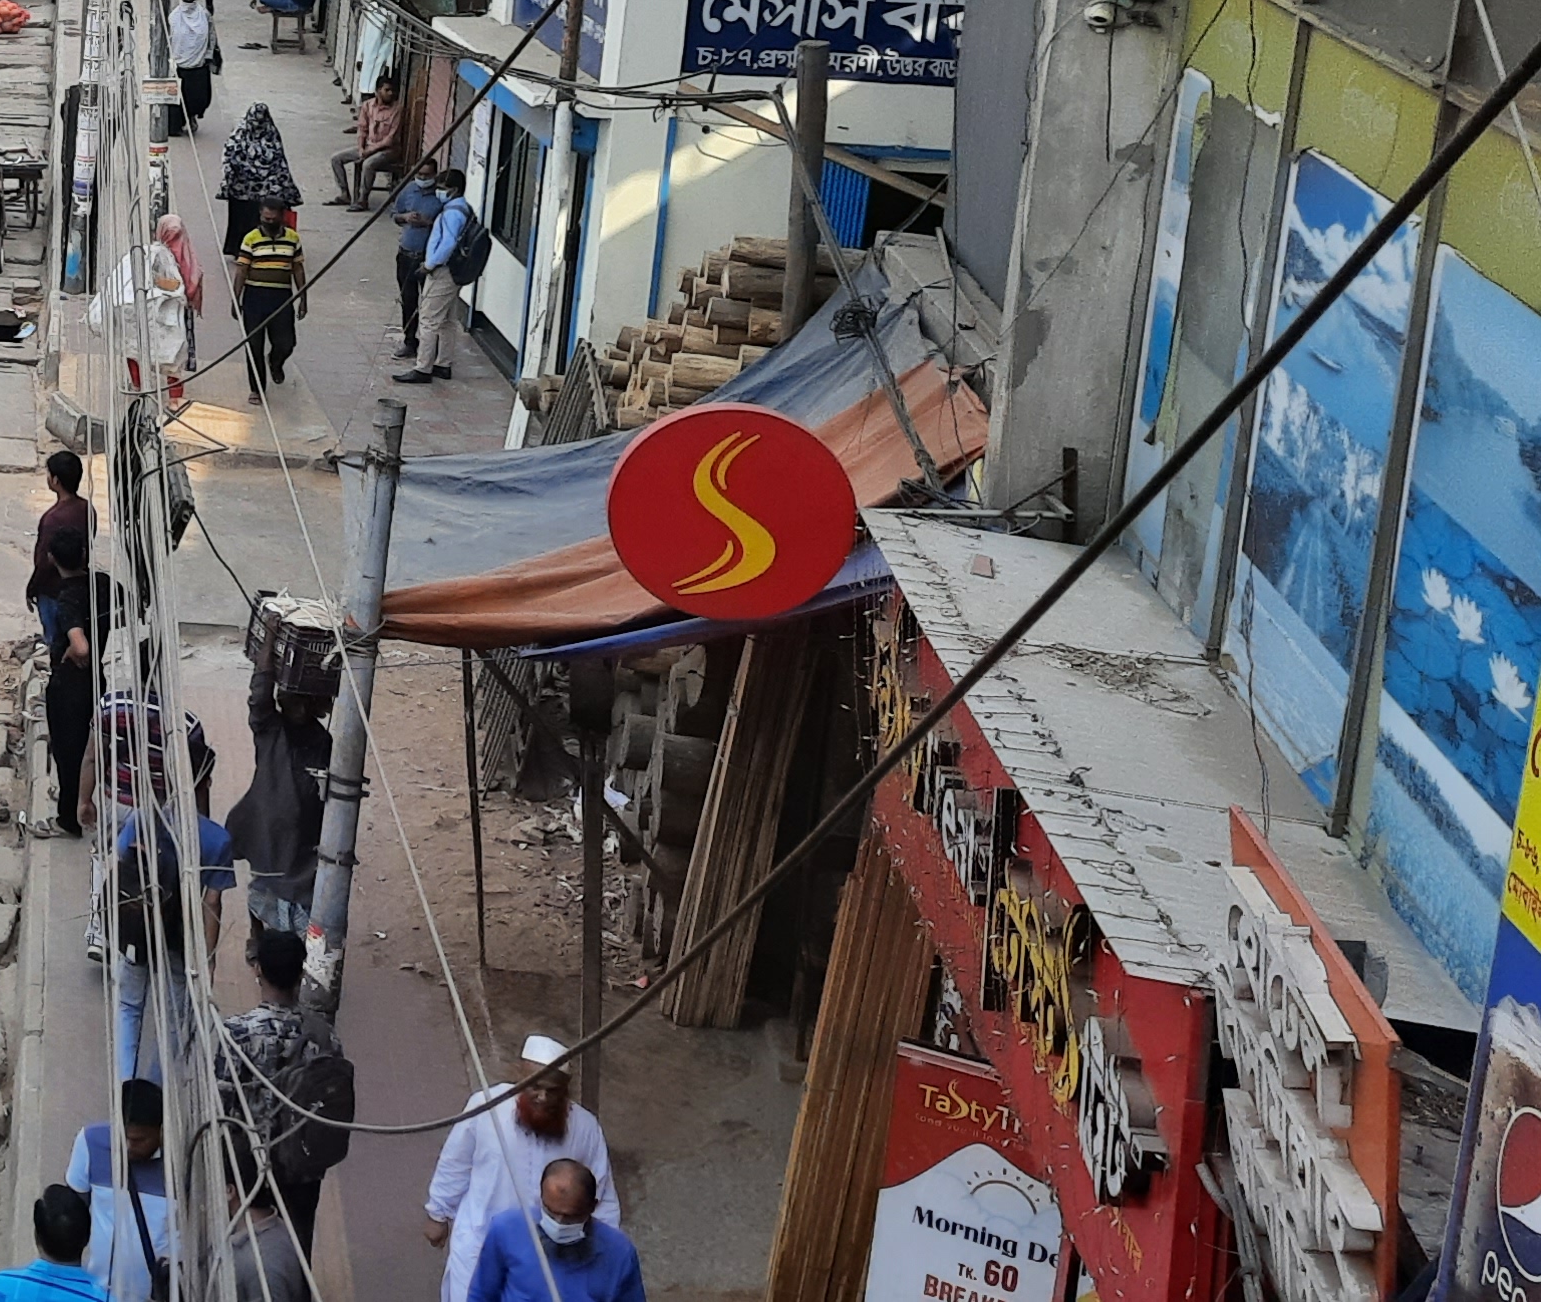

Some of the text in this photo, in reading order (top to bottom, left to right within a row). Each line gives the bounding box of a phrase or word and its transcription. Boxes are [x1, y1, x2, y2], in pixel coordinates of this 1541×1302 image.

[912, 1205, 1060, 1269] Morning De
[957, 1259, 1019, 1293] TK. 60
[1480, 1249, 1529, 1302] pe
